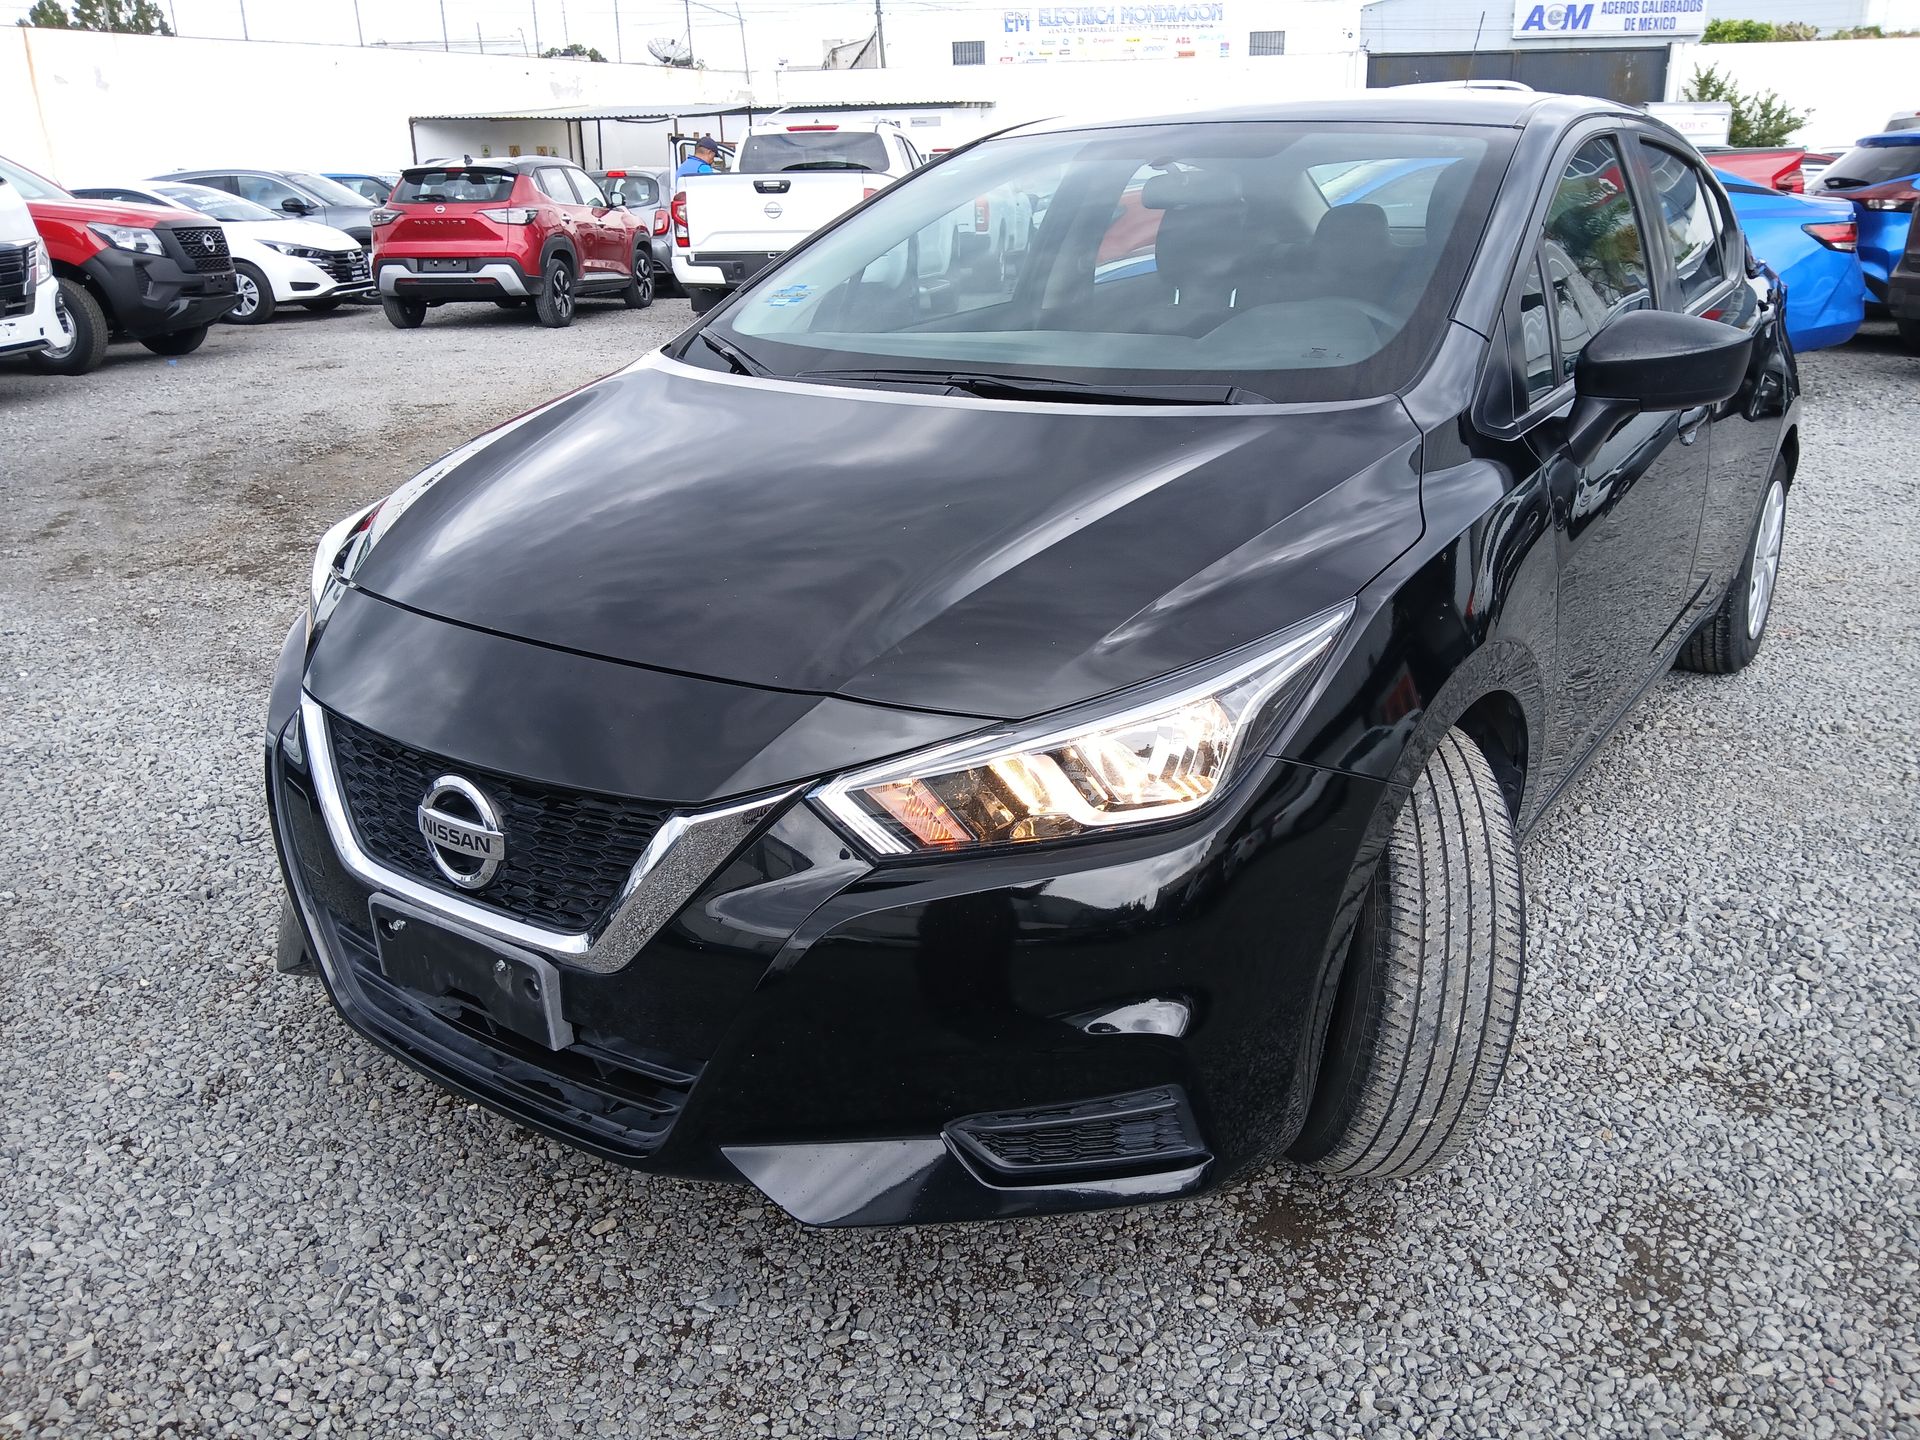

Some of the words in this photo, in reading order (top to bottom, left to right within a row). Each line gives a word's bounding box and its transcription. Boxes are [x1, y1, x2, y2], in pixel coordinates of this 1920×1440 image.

[1038, 7, 1115, 26] ELECTRICA
[1120, 3, 1223, 24] MONDRAGON
[1601, 1, 1639, 15] ACEROS
[1641, 0, 1703, 14] CALIBRADOS
[1004, 12, 1030, 32] EM
[1624, 18, 1637, 31] DE
[423, 816, 490, 853] NISSAN
